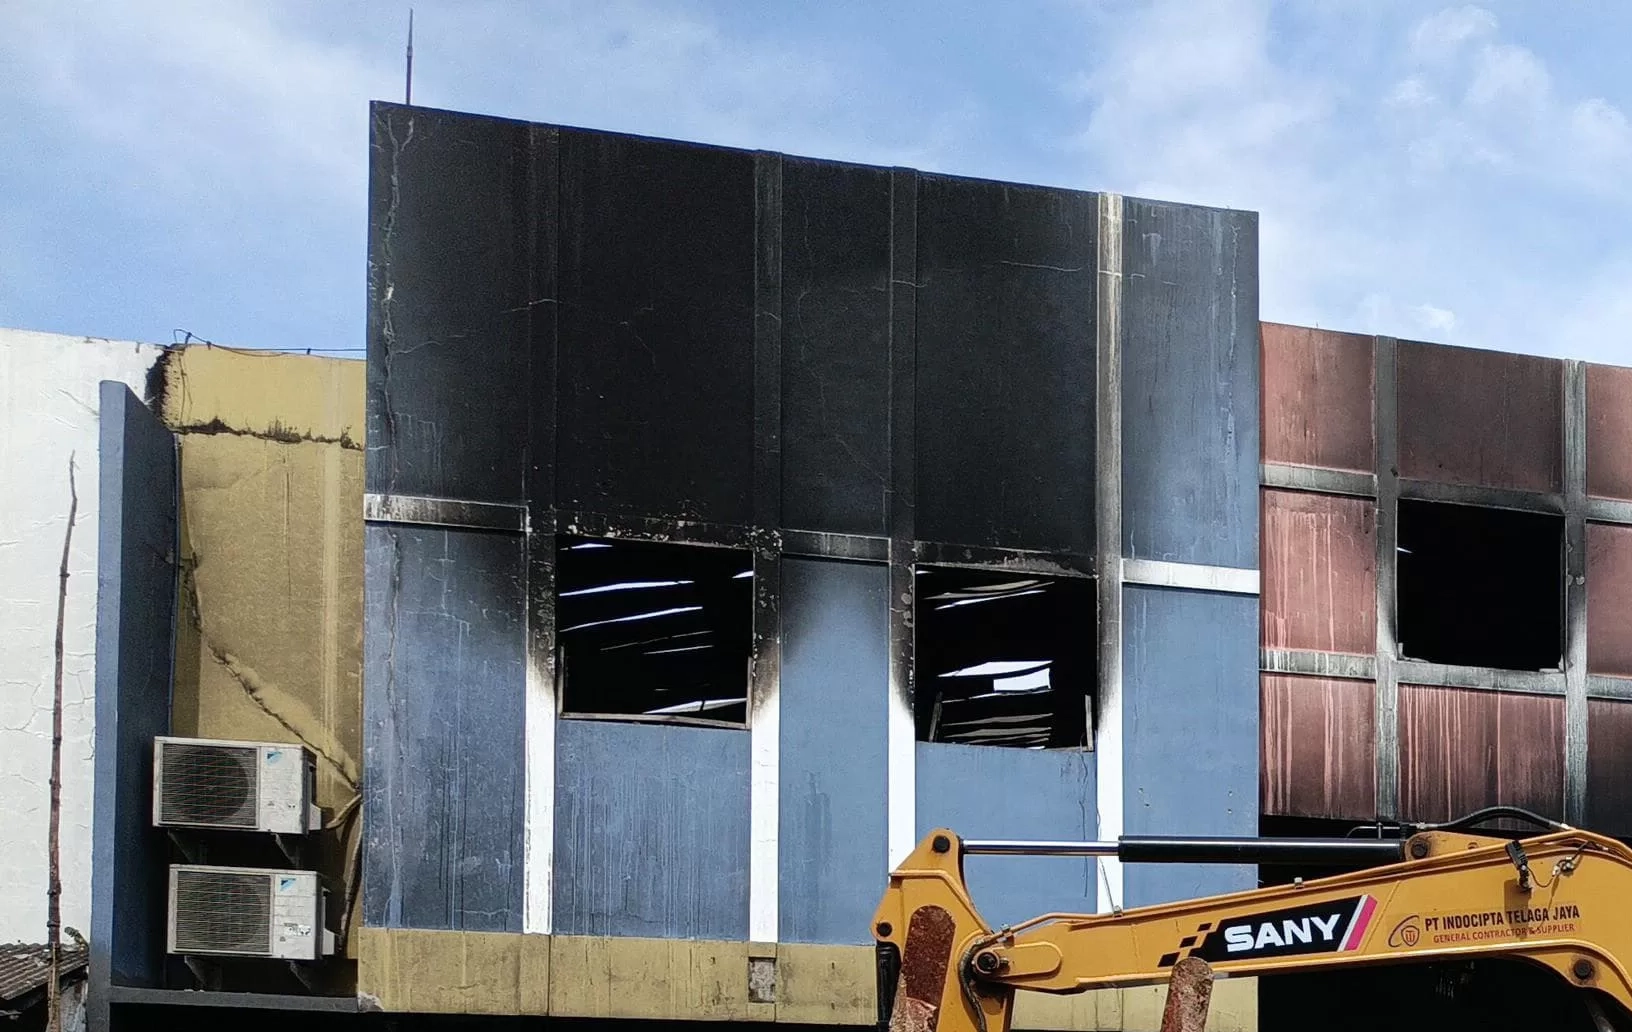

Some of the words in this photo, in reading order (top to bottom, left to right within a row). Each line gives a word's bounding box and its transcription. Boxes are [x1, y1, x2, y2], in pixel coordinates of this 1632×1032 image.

[1425, 917, 1439, 931] PT
[1442, 912, 1504, 930] INDOCIPTA
[1506, 908, 1549, 924] TELAGA
[1553, 905, 1580, 921] JAYA
[1224, 914, 1341, 952] SANY
[1433, 933, 1470, 944] GENERAL
[1472, 927, 1527, 941] CONTRACTOR
[1536, 923, 1575, 935] SUPPLIER
